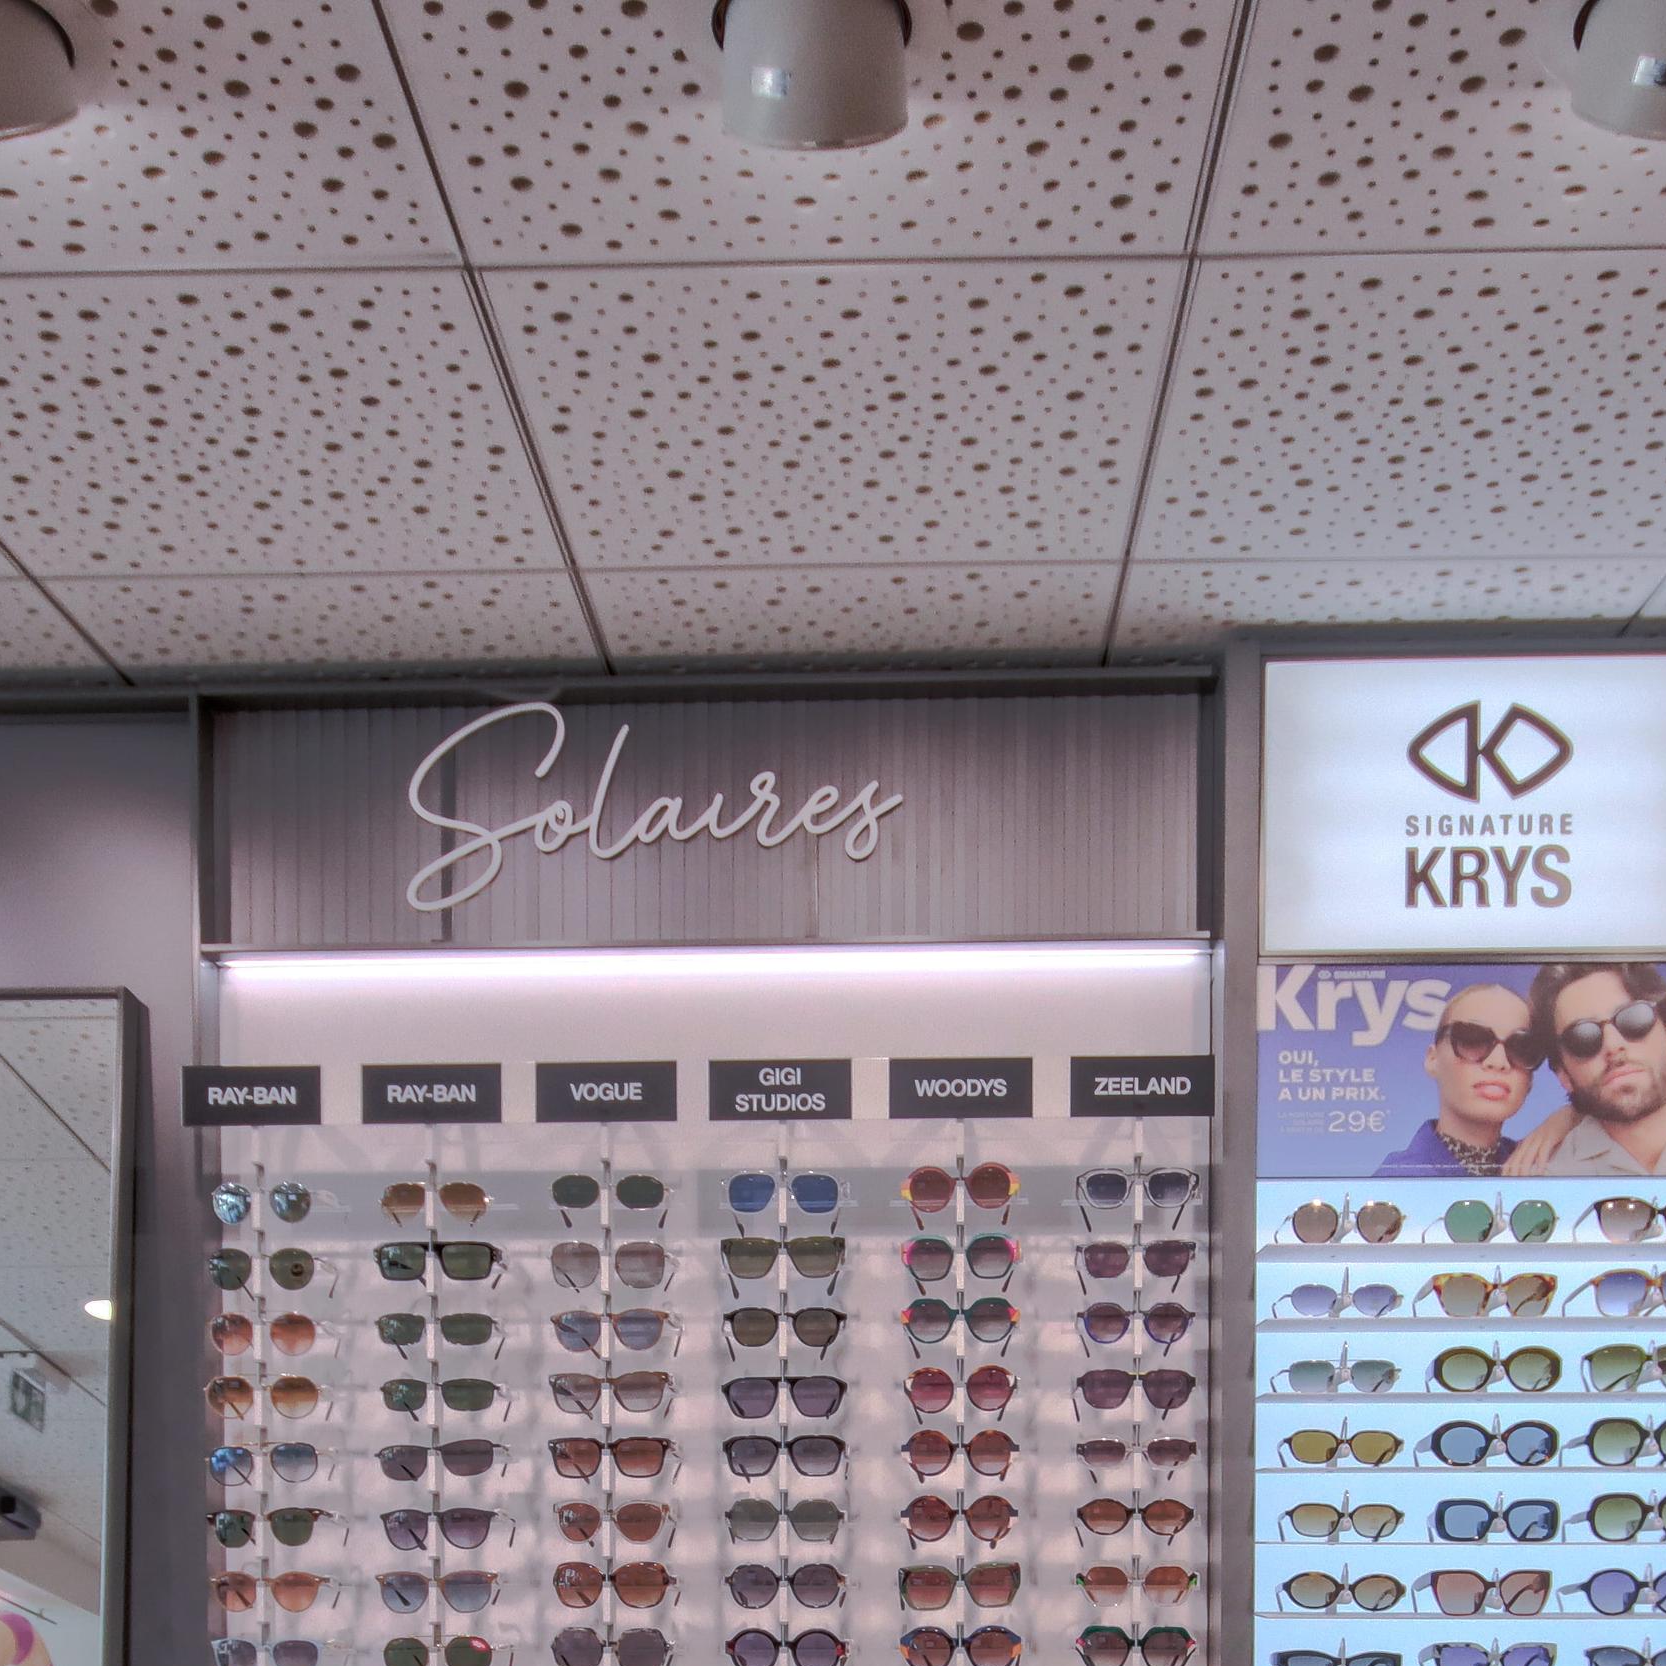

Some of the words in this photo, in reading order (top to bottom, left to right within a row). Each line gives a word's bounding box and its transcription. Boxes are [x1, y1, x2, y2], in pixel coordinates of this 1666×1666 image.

[406, 702, 904, 912] Solaires
[1406, 813, 1573, 836] SIGNATURE
[1405, 843, 1573, 908] KRYS
[1257, 965, 1452, 1047] Krys
[1278, 1051, 1319, 1066] OUI,
[758, 1067, 802, 1087] GIGI
[1279, 1069, 1303, 1083] LE
[1309, 1068, 1376, 1083] STYLE
[208, 1085, 297, 1105] RAY-BAN
[387, 1084, 477, 1103] RAY-BAN
[570, 1082, 644, 1101] VOGUE
[915, 1078, 1008, 1098] WOODYS
[1094, 1076, 1192, 1097] ZEELAND
[1298, 1087, 1325, 1101] UN
[1332, 1087, 1386, 1101] PRIX.
[735, 1092, 826, 1112] STUDIOS
